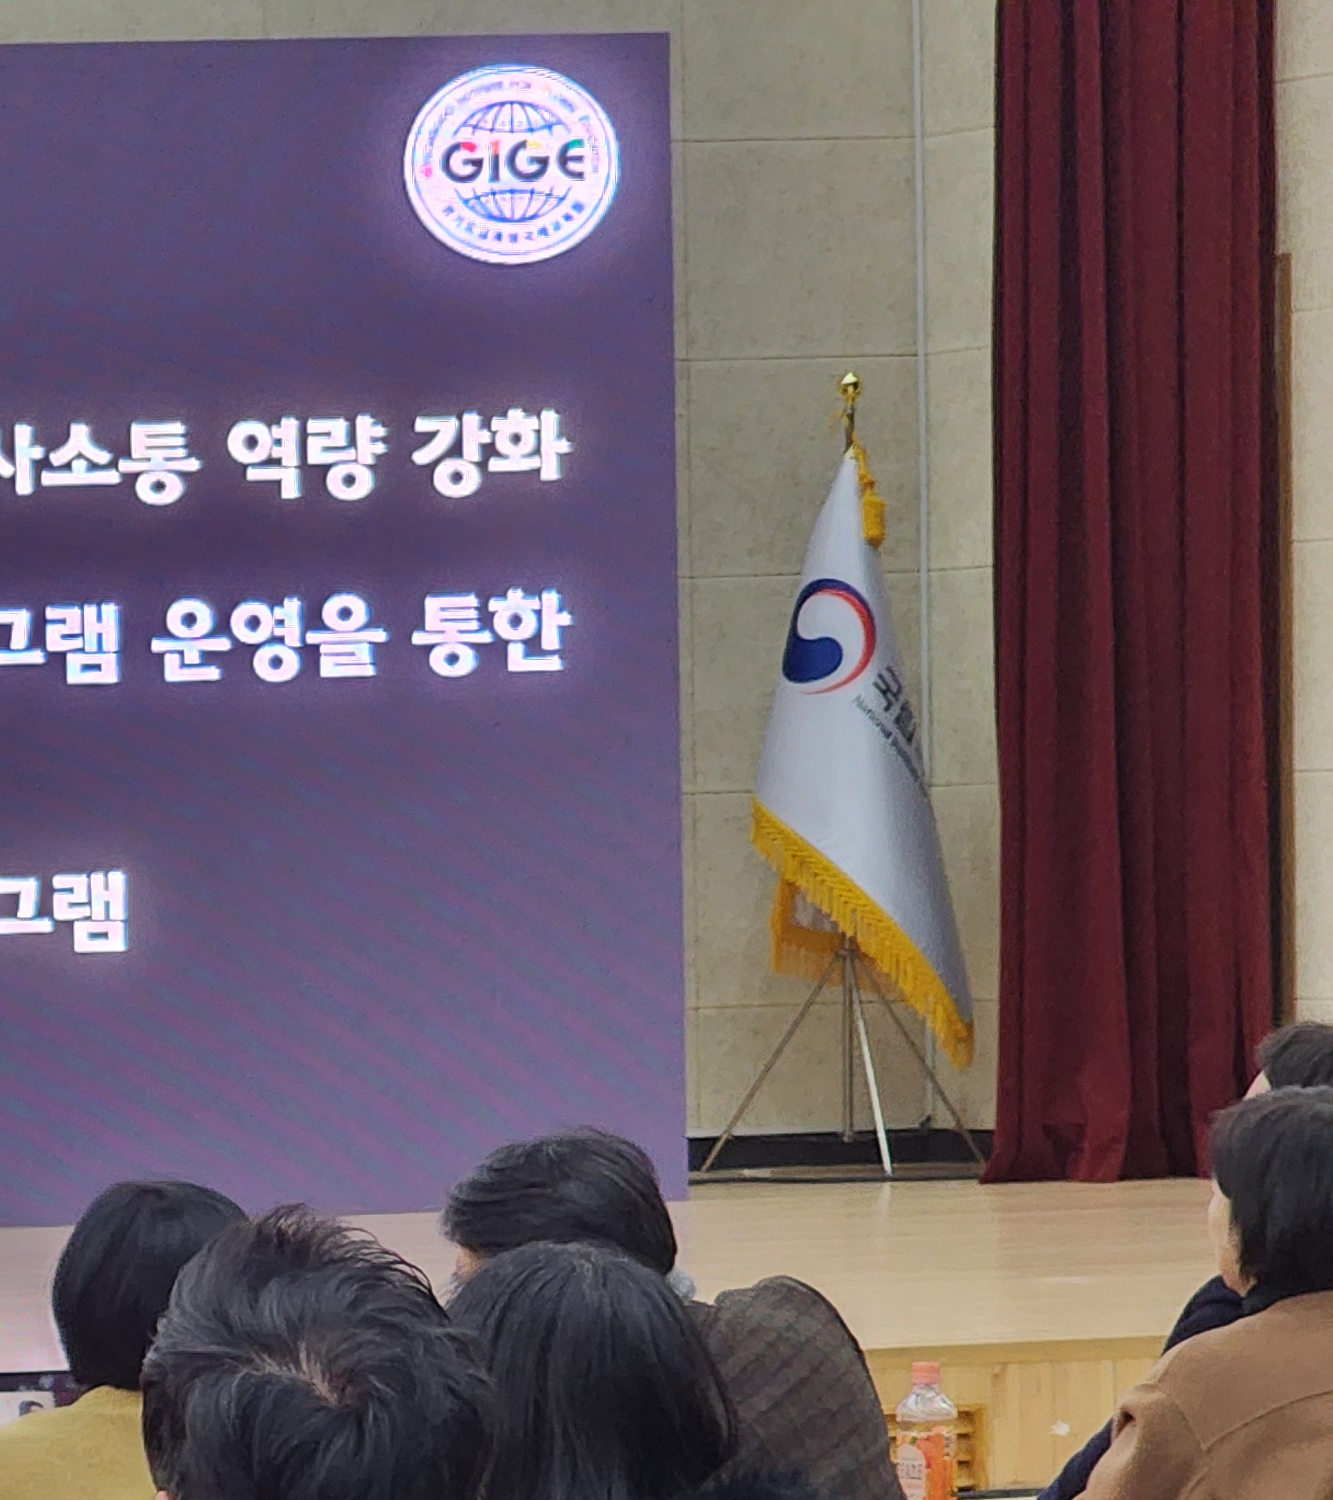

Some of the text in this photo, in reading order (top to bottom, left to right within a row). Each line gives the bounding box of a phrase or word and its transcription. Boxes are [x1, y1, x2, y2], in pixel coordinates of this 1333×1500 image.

[442, 139, 586, 184] GIGE
[228, 415, 387, 500] 역량
[412, 409, 571, 497] 강화
[151, 594, 387, 682] 운영을
[412, 589, 572, 677] 통한
